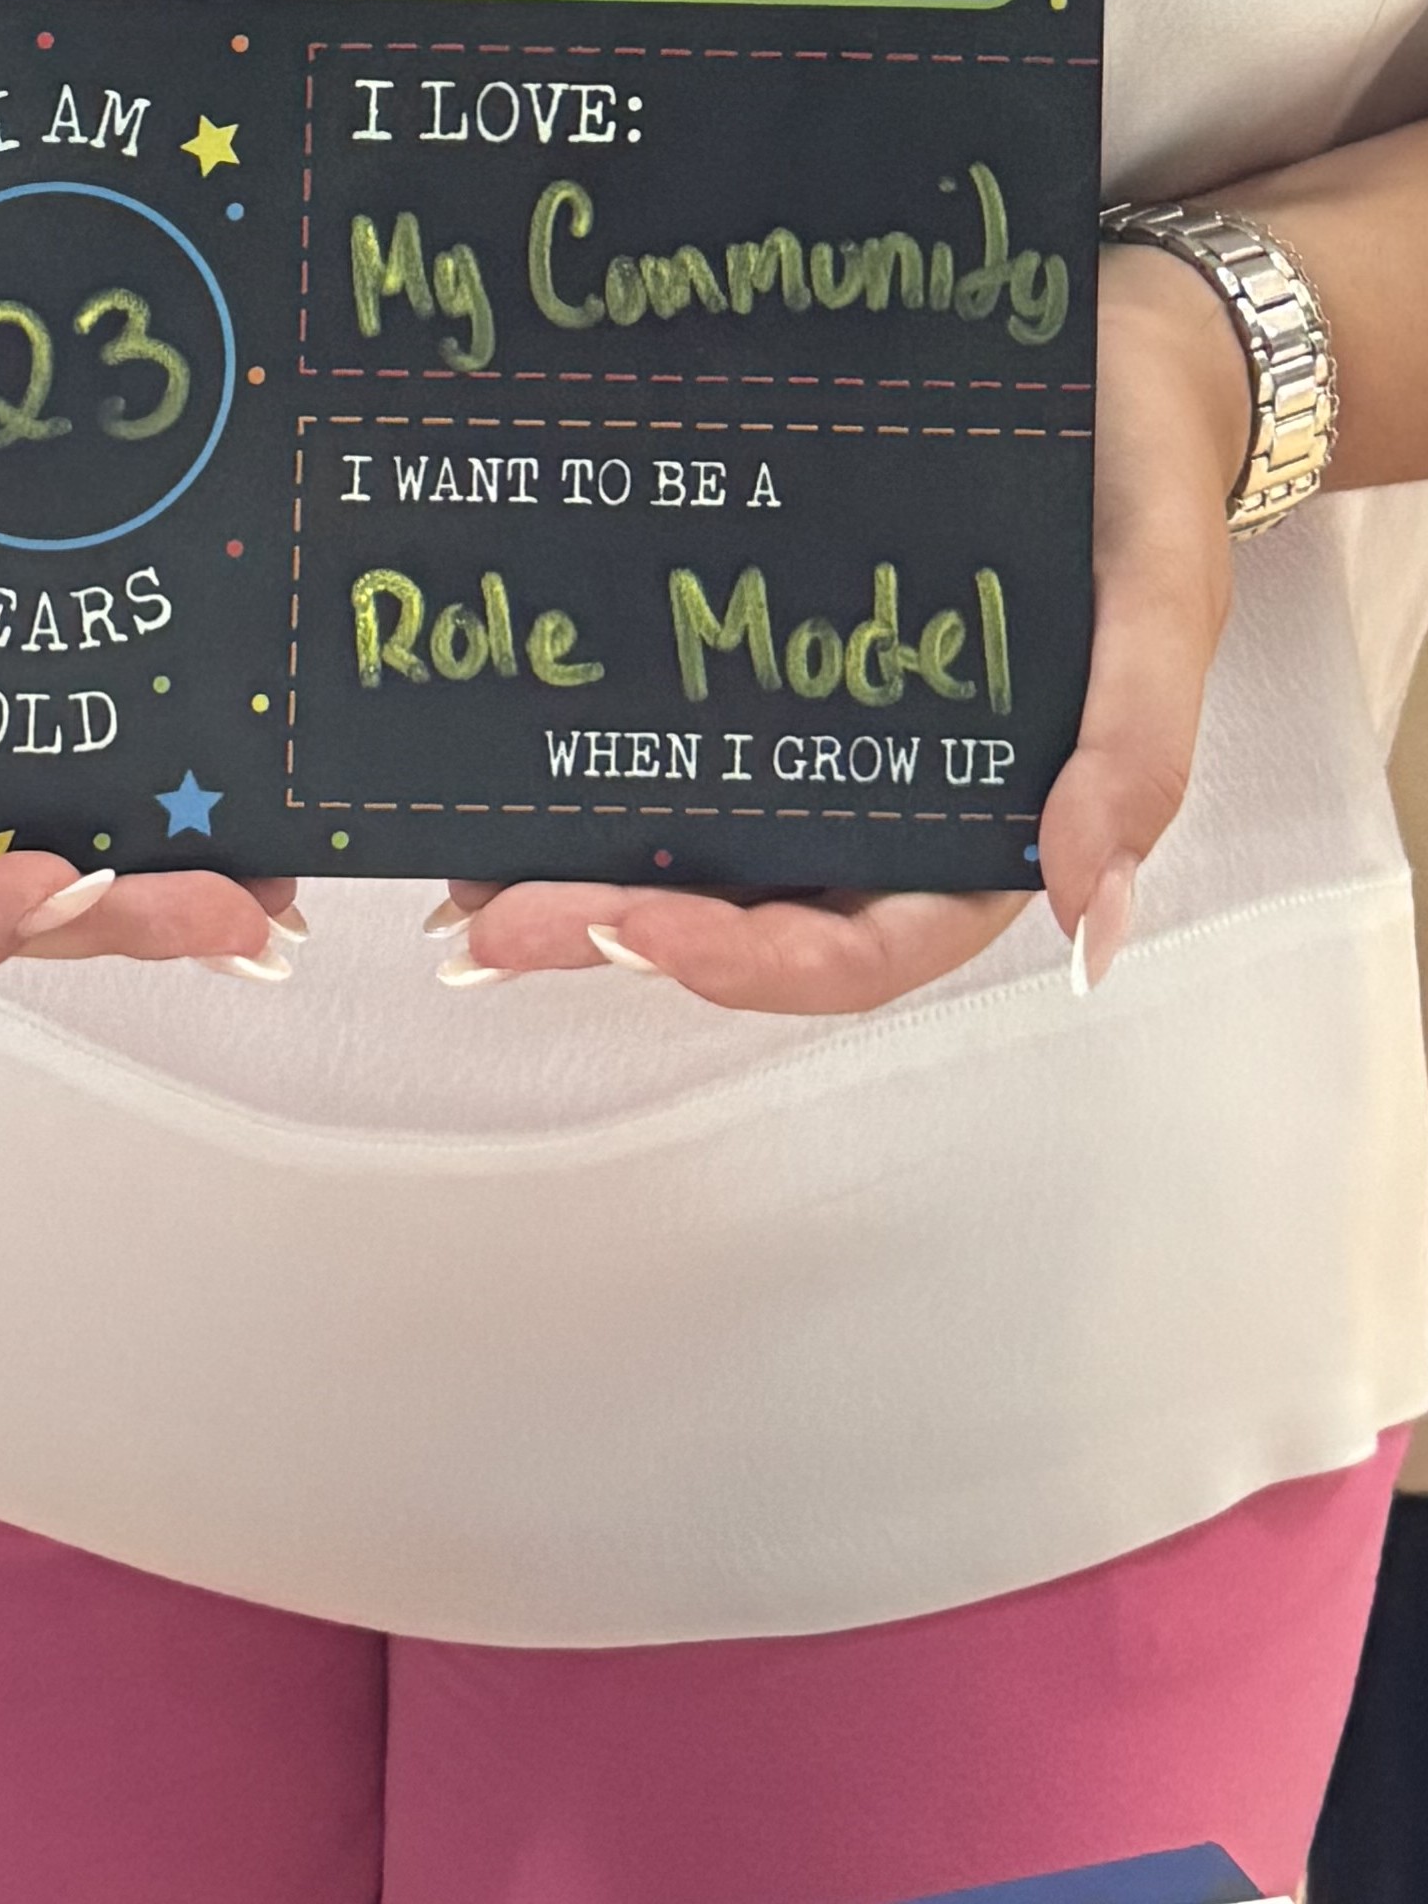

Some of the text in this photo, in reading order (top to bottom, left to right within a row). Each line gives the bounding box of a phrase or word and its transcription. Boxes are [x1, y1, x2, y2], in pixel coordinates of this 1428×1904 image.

[40, 83, 152, 158] AM
[351, 78, 644, 145] I LOVE:
[349, 161, 1070, 373] My Community
[339, 453, 783, 509] I WANT TO BE A
[349, 561, 1012, 717] Role Model
[544, 729, 1016, 786] WHEN I GROW UP
